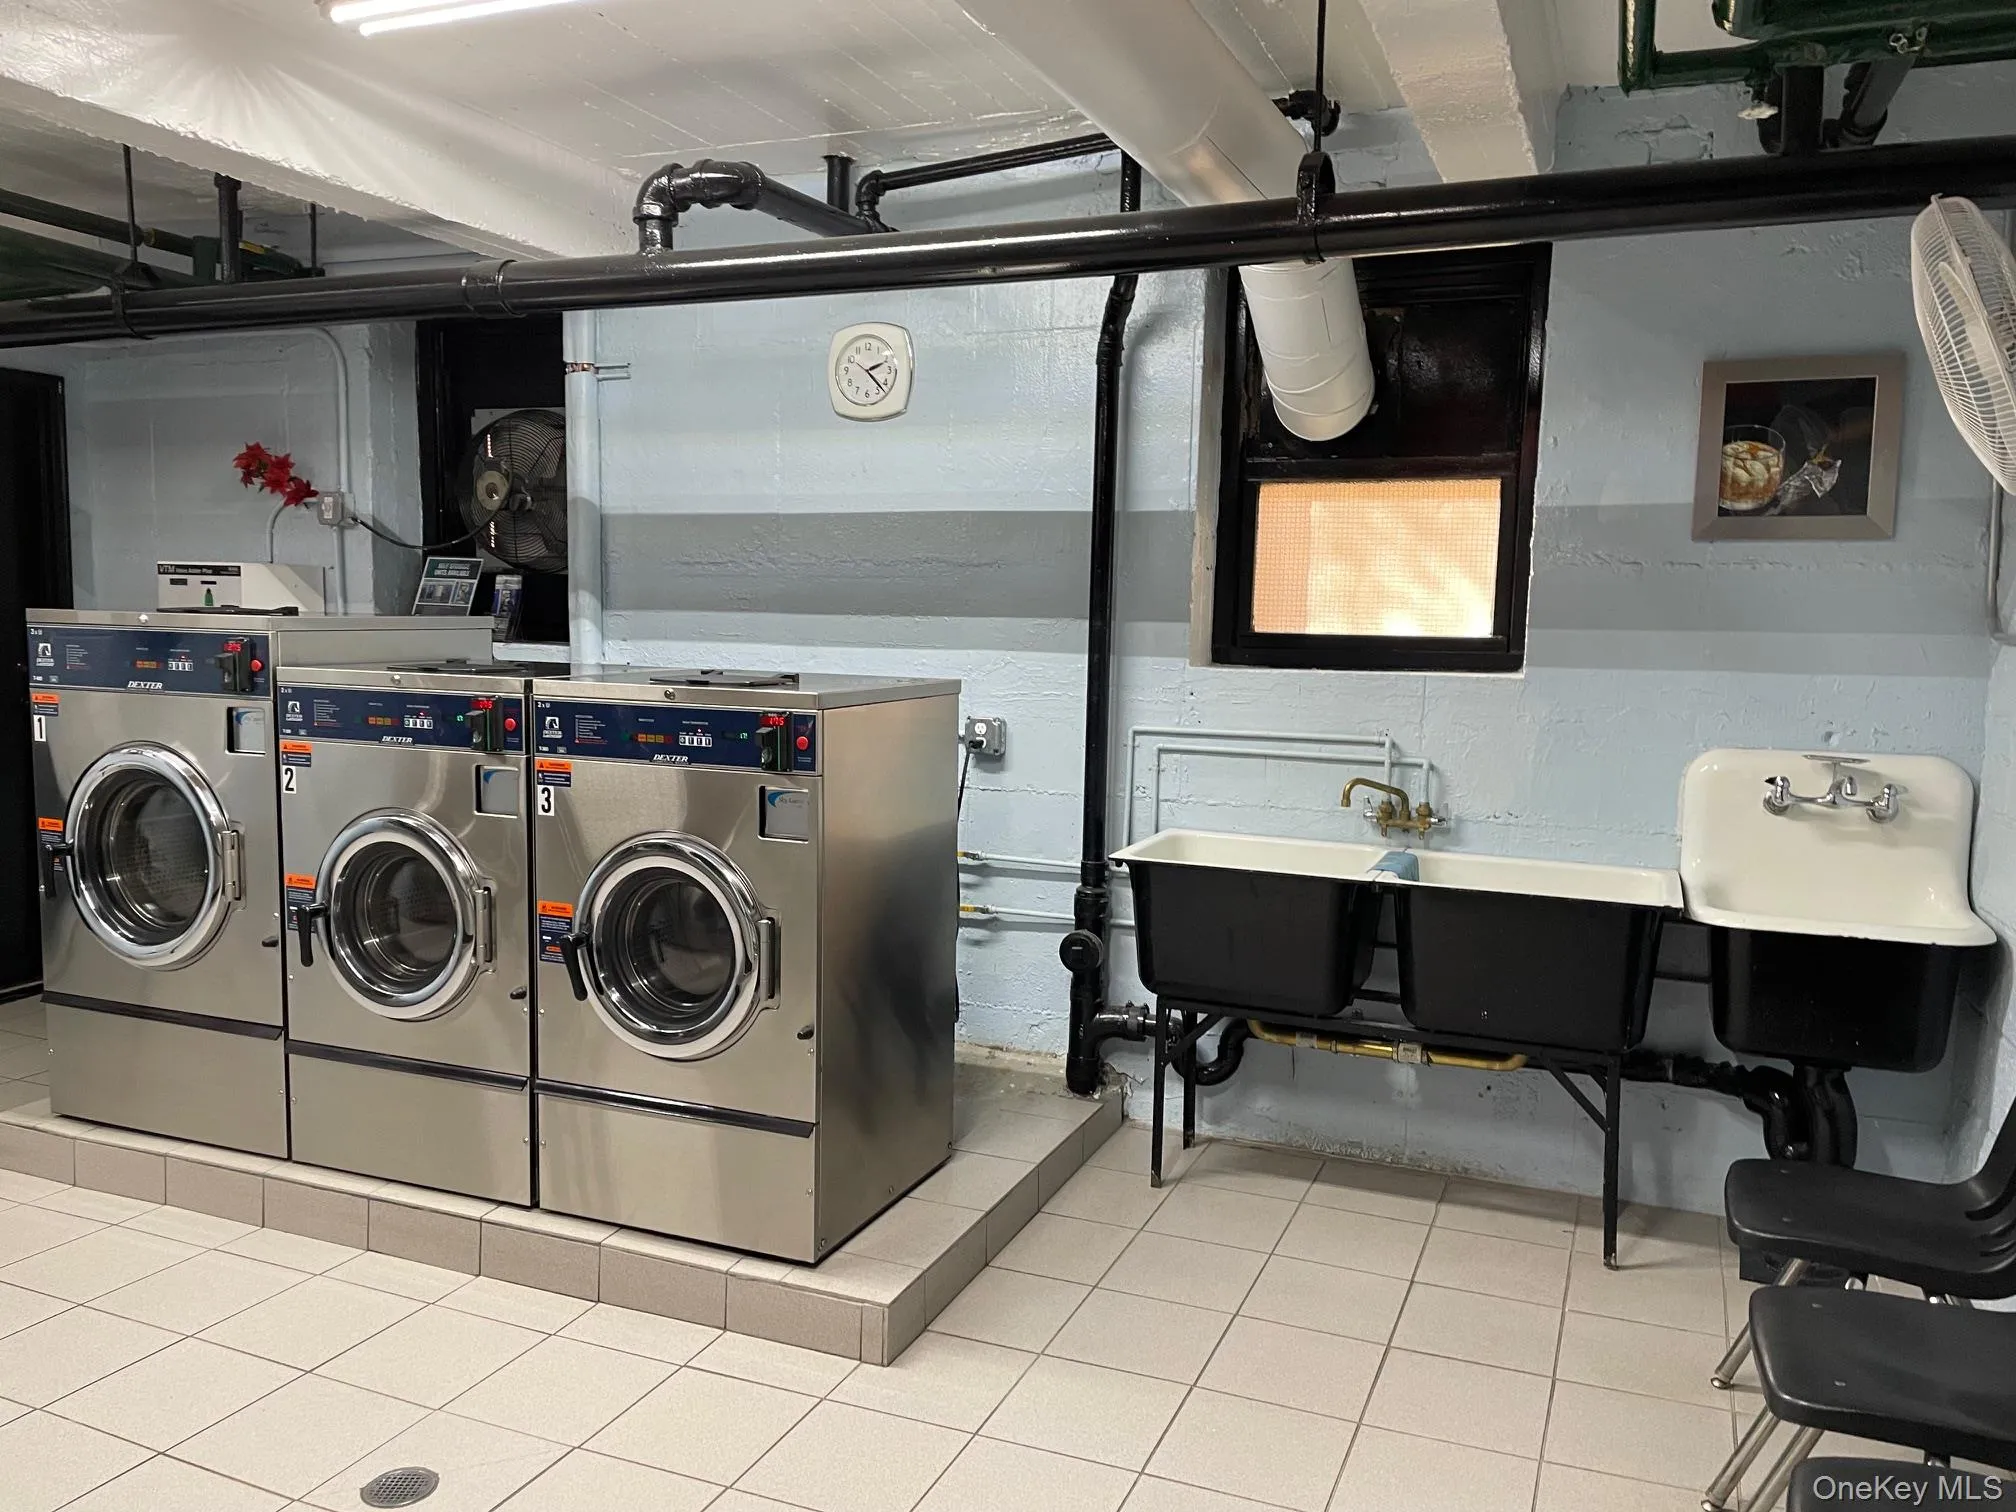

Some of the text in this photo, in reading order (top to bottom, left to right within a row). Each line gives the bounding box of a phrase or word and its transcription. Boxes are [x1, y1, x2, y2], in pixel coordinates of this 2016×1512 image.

[855, 346, 861, 354] 11
[865, 342, 872, 351] 12
[847, 355, 855, 364] 10
[843, 366, 849, 375] 9
[887, 366, 892, 374] 3
[847, 378, 853, 387] 8
[882, 378, 887, 386] 4
[855, 386, 860, 394] 7
[864, 389, 870, 398] 6
[875, 387, 880, 395] 5
[160, 565, 175, 573] VTM
[127, 680, 163, 689] DEXTER
[37, 717, 43, 740] 1
[381, 735, 413, 744] DEXTER
[653, 753, 689, 763] DEXTER
[284, 767, 295, 792] 2
[541, 787, 551, 814] 3
